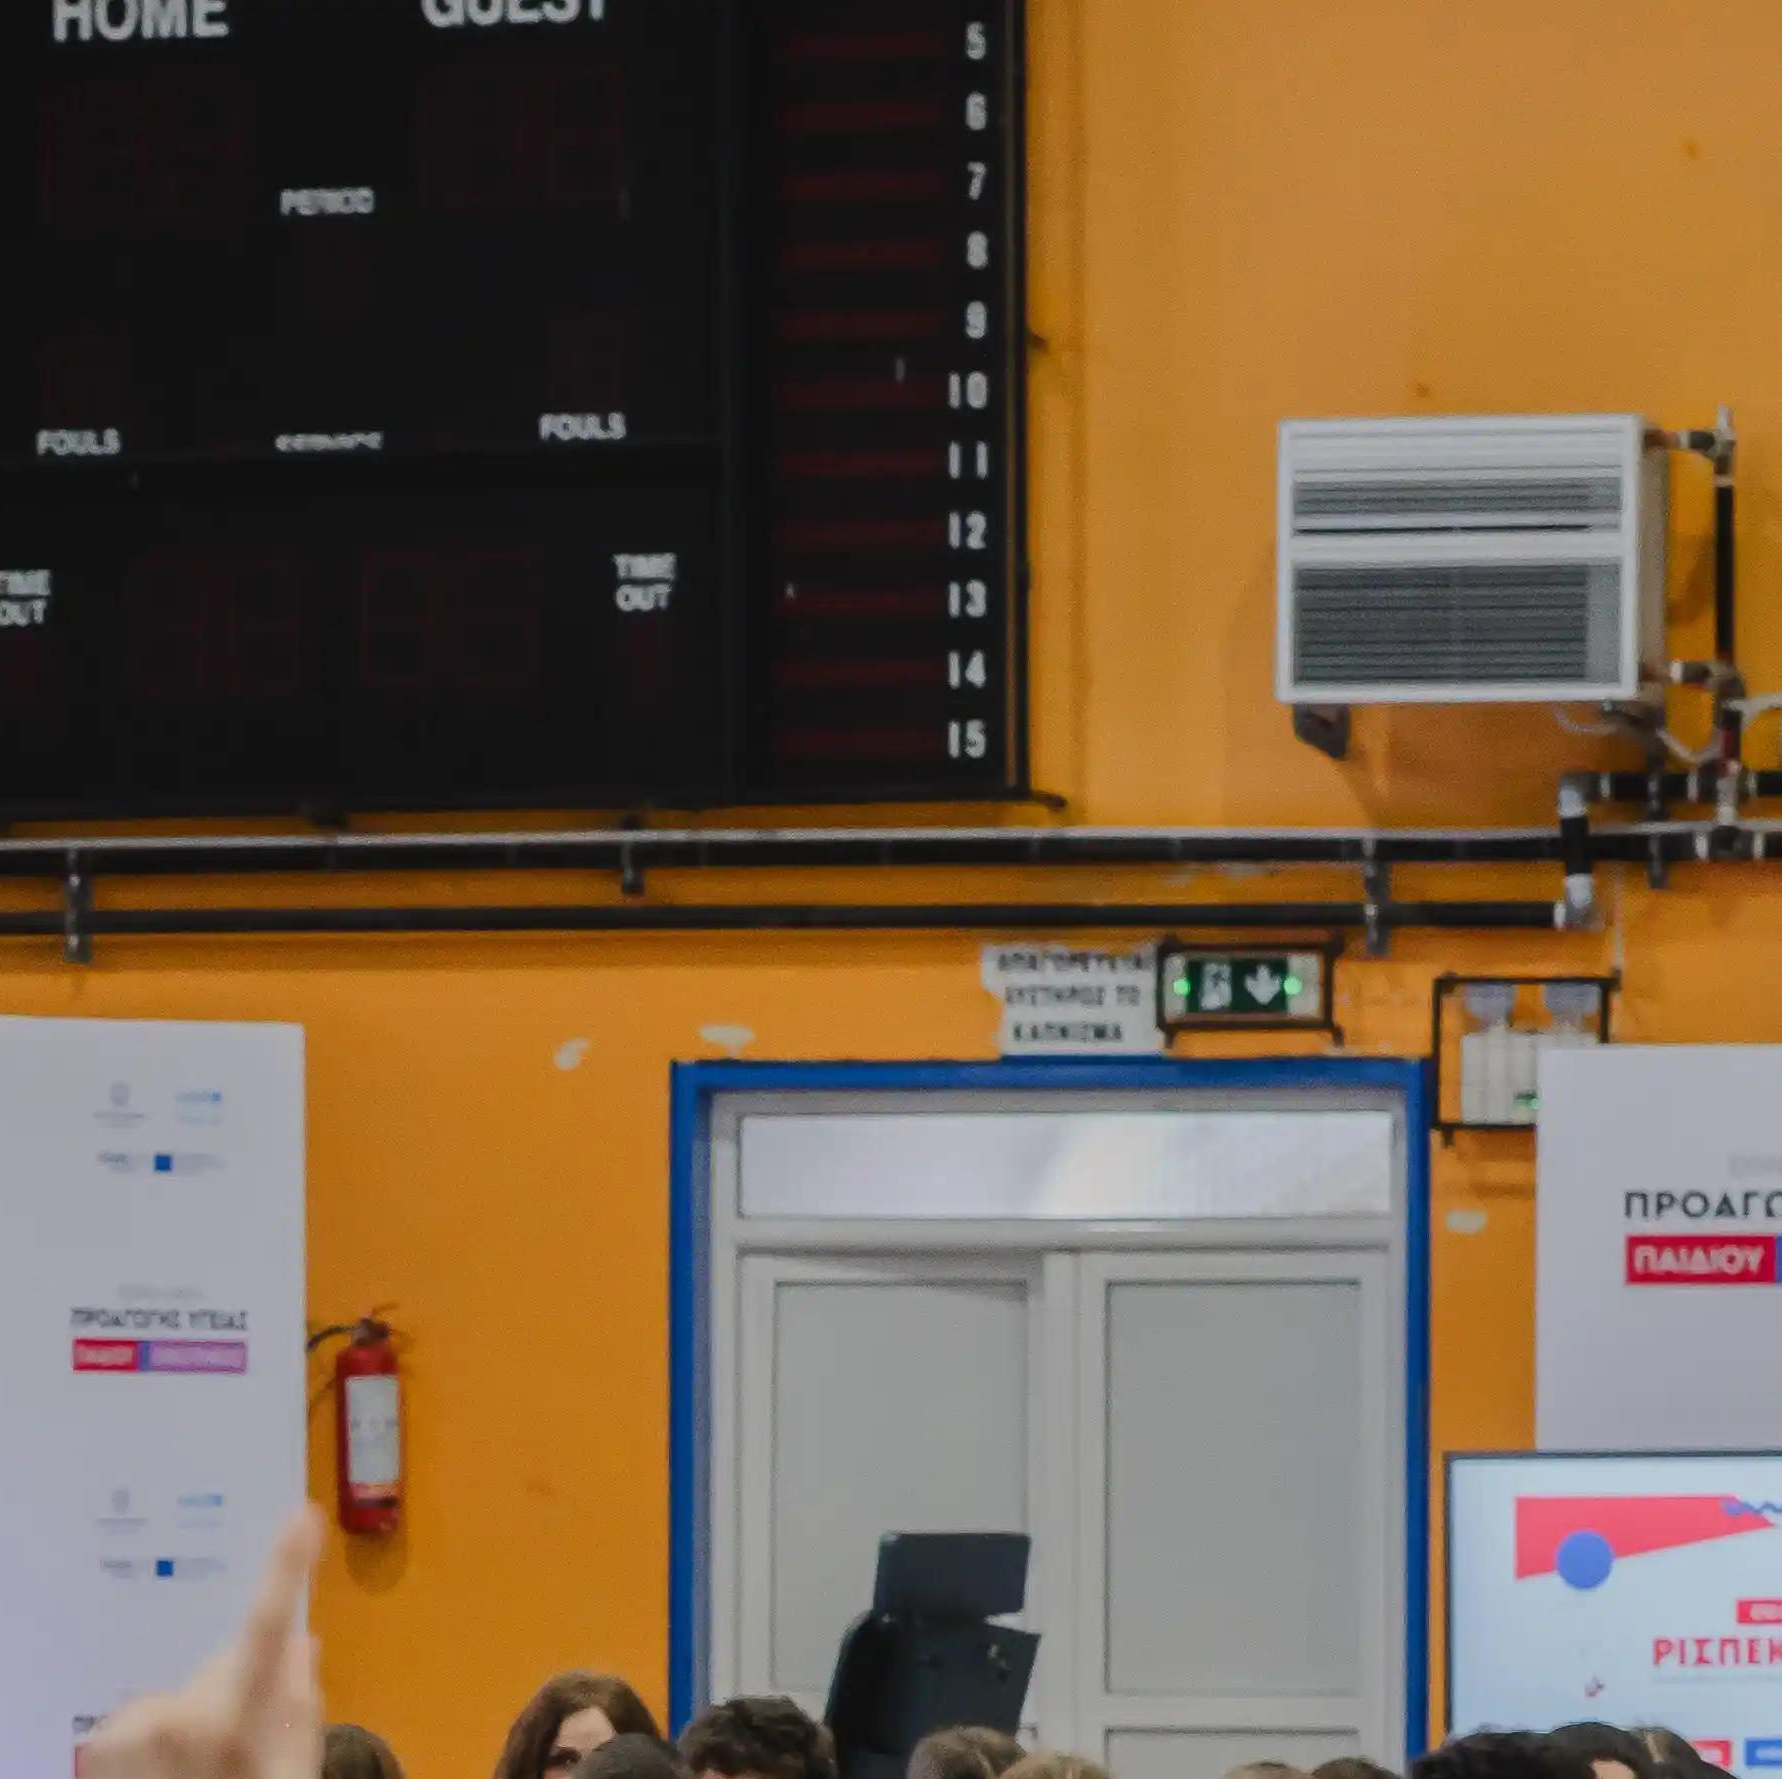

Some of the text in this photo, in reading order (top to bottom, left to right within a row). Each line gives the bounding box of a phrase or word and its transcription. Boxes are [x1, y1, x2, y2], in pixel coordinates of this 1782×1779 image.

[53, 0, 229, 43] HOME
[966, 21, 986, 60] 5
[967, 161, 987, 200] 7
[279, 187, 374, 216] PERIOD
[948, 371, 988, 409] 10
[36, 428, 121, 456] FOULS
[538, 412, 627, 441] FOULS
[948, 441, 989, 479] 11
[948, 511, 987, 550] 12
[613, 552, 676, 581] TIME
[615, 582, 672, 612] OUT
[948, 579, 987, 618] 13
[947, 650, 987, 689] 14
[947, 719, 987, 759] 15
[1634, 1244, 1766, 1276] ΠΑΙΔΙΟΥ
